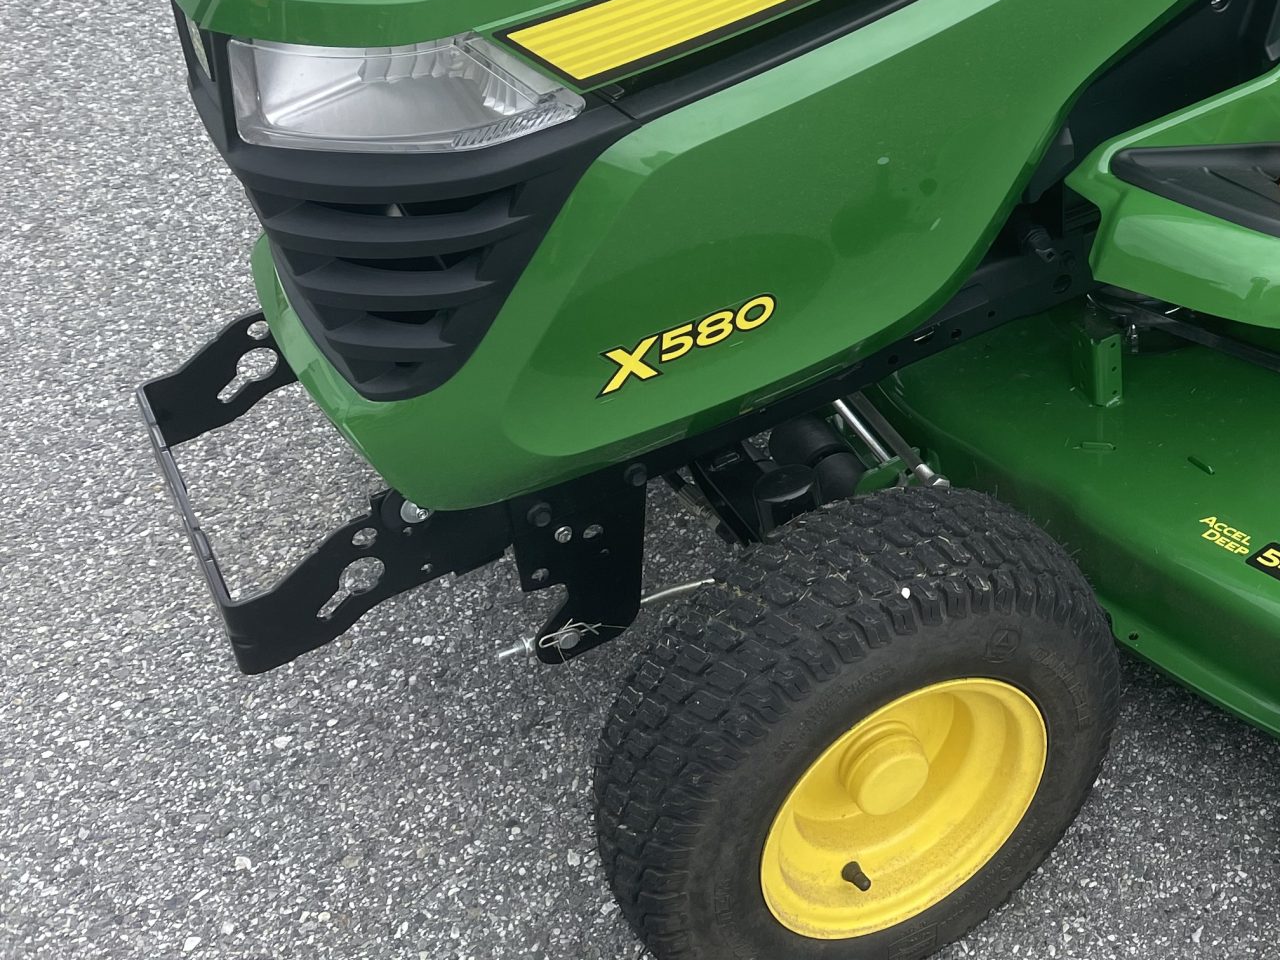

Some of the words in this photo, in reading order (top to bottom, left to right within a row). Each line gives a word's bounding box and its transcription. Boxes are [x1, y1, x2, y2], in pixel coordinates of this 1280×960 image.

[597, 293, 777, 398] X580
[1199, 516, 1252, 546] ACCEL
[1201, 528, 1250, 556] DEEP
